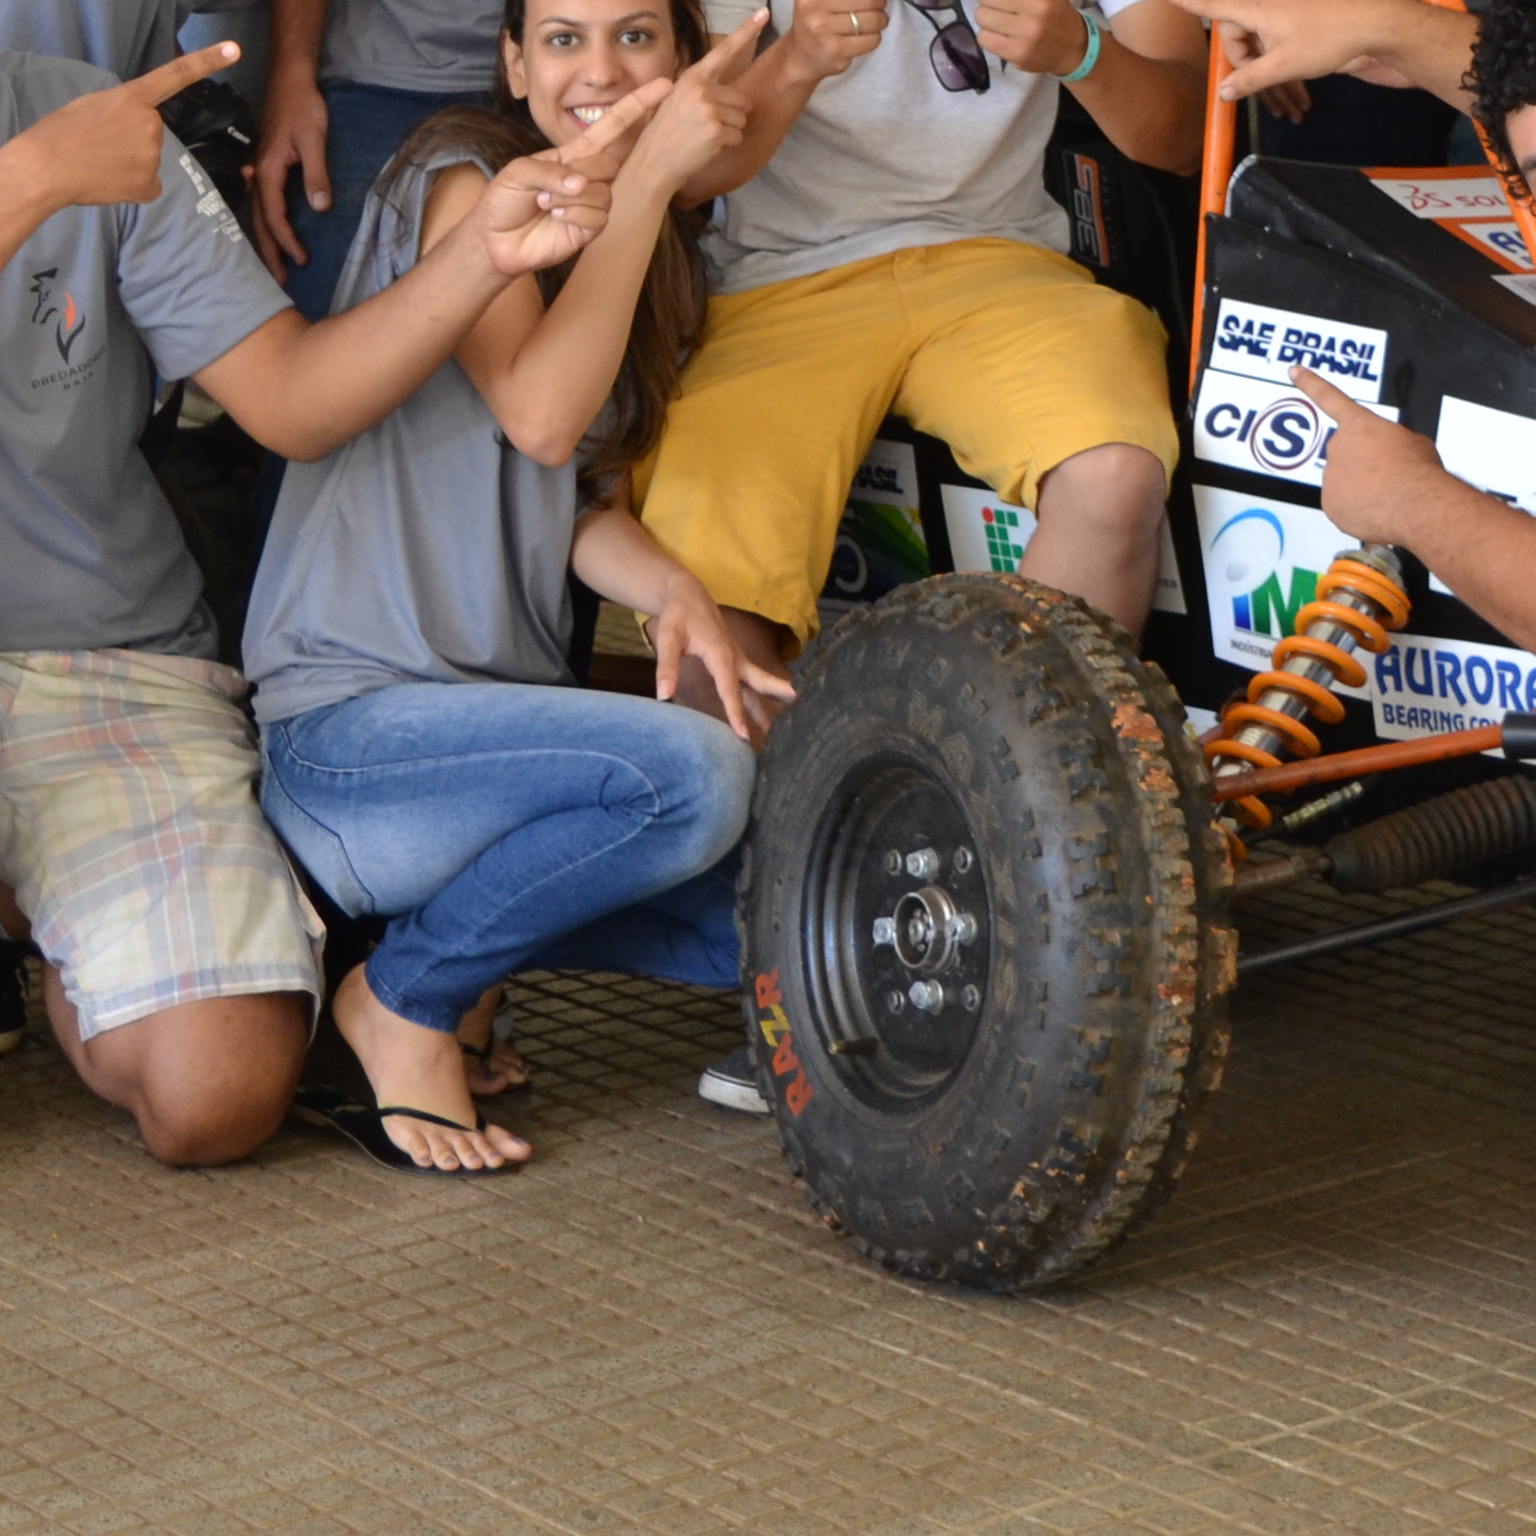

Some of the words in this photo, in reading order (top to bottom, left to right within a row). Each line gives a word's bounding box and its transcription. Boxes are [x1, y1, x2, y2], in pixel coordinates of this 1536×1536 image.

[1217, 314, 1276, 362] SAE
[1276, 326, 1379, 383] BRASIL
[1381, 701, 1465, 734] BEARING
[755, 966, 814, 1120] RAZR
